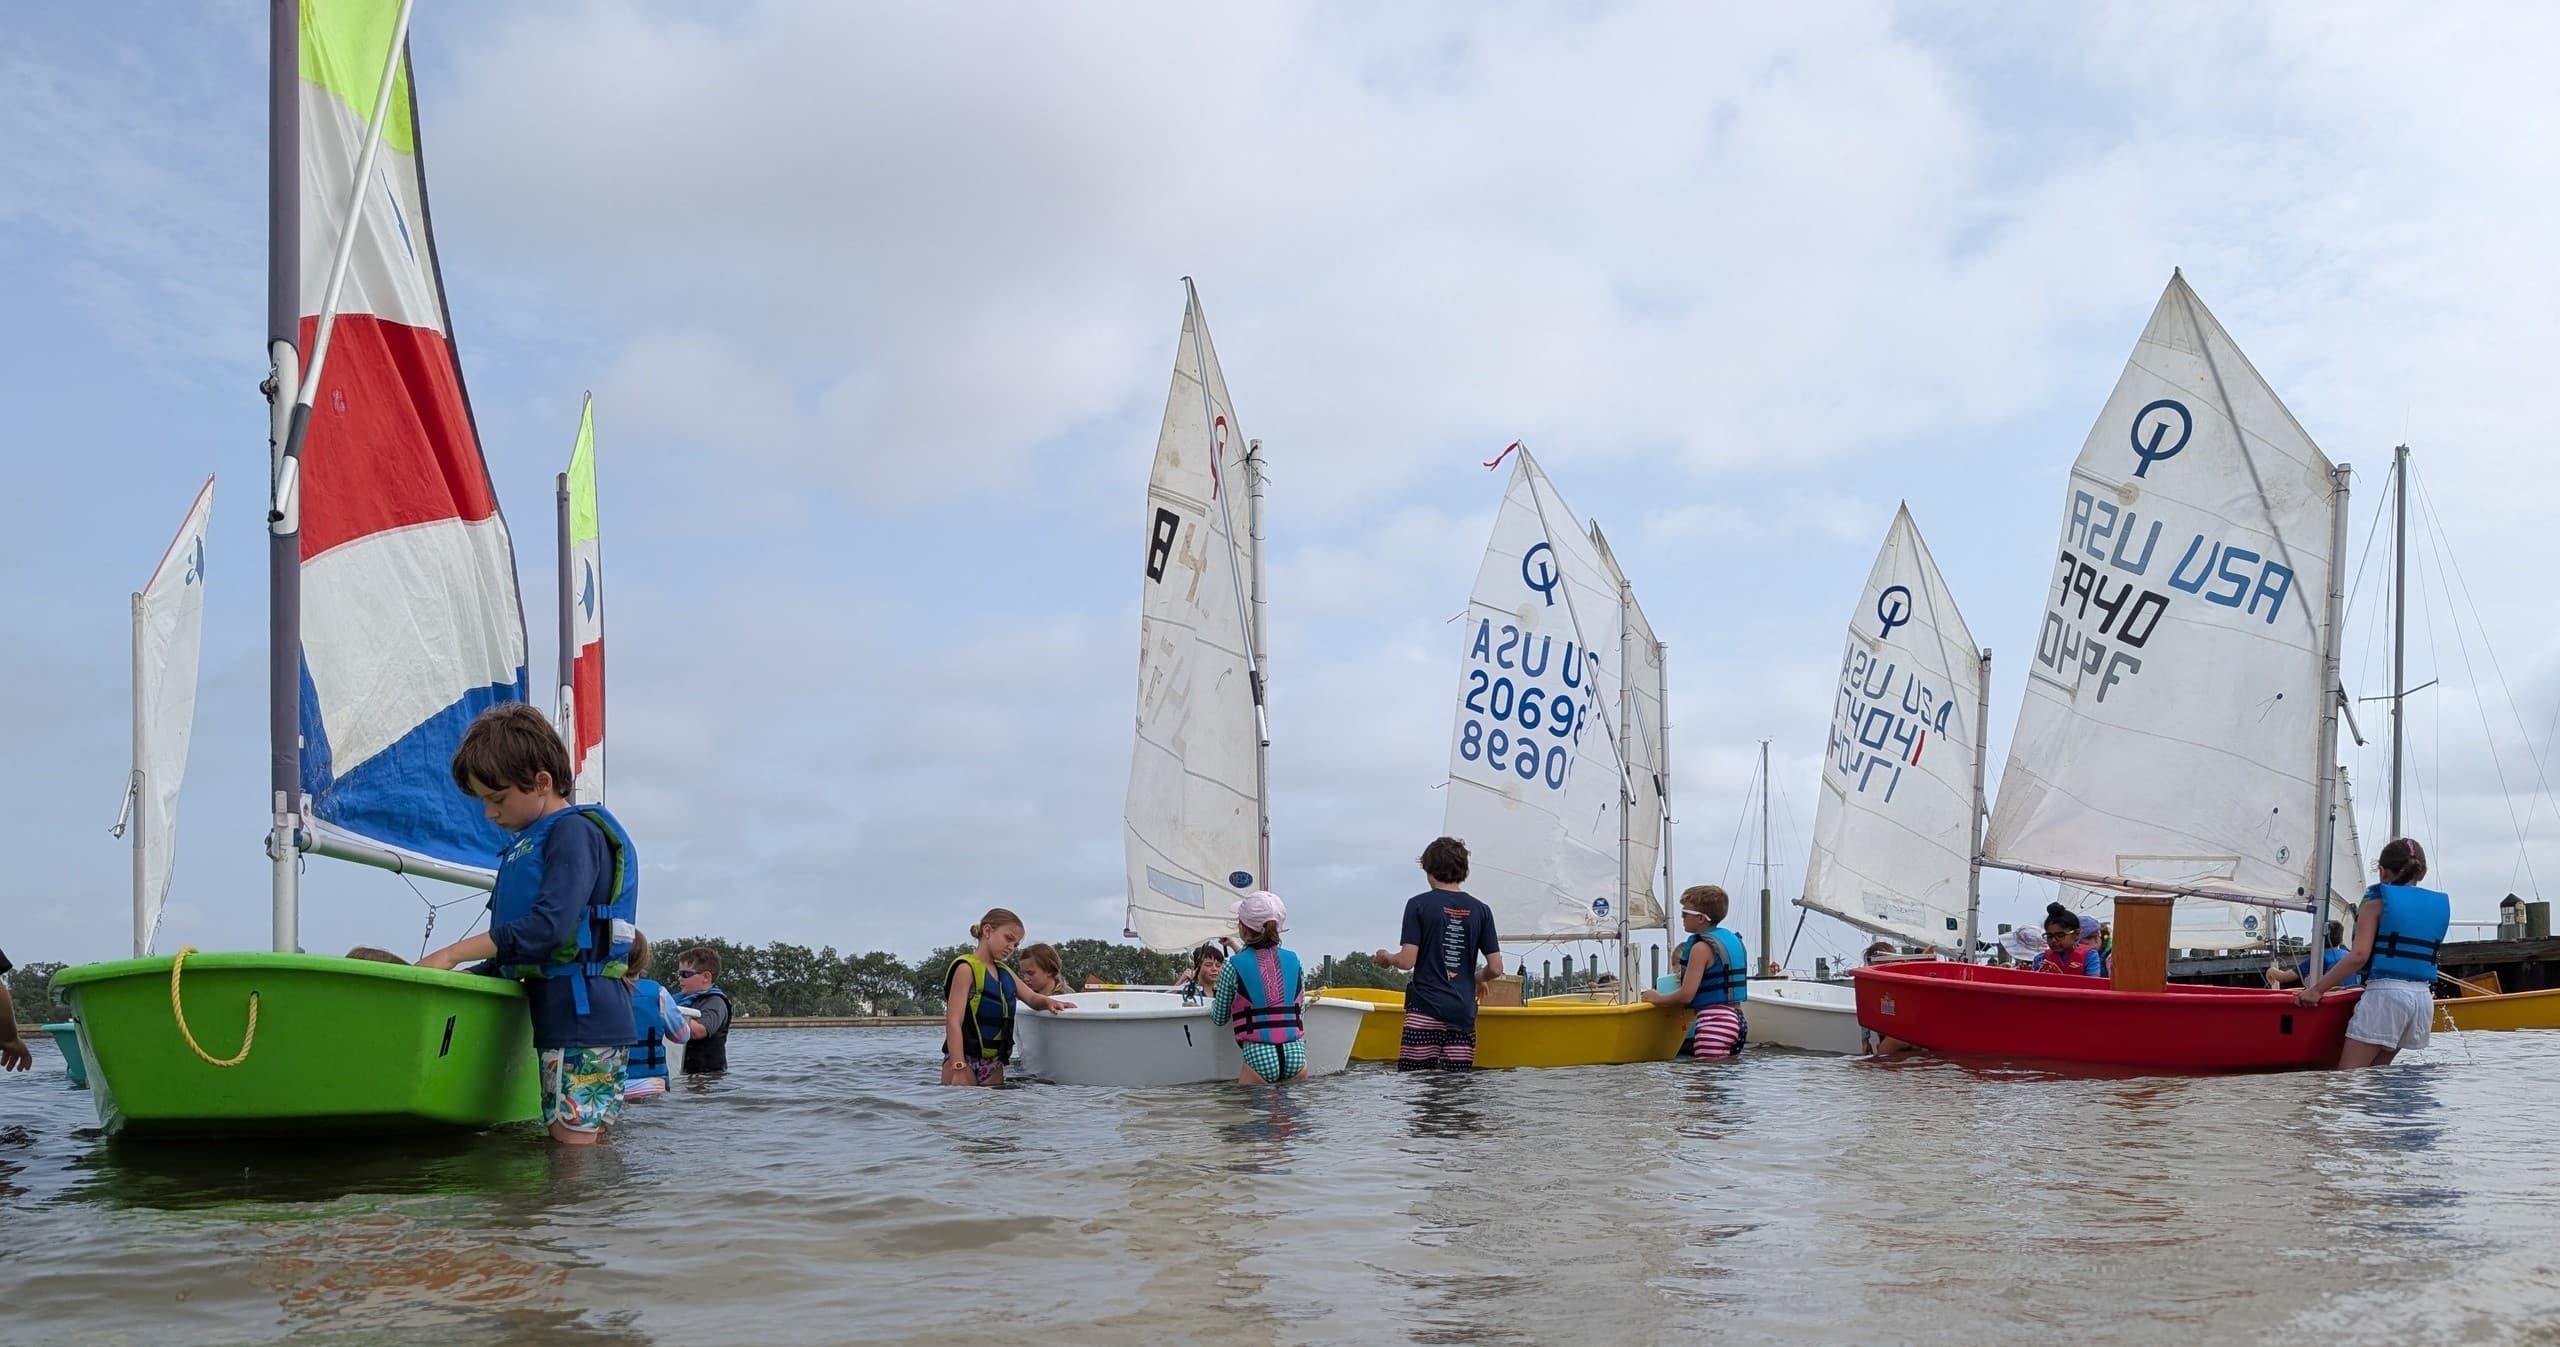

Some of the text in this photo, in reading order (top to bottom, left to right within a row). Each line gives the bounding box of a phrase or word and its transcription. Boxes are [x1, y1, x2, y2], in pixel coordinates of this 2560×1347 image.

[2060, 550, 2170, 649] 7940
[2168, 534, 2294, 624] USA
[1465, 669, 1587, 748] 20698
[1902, 672, 1953, 741] USA
